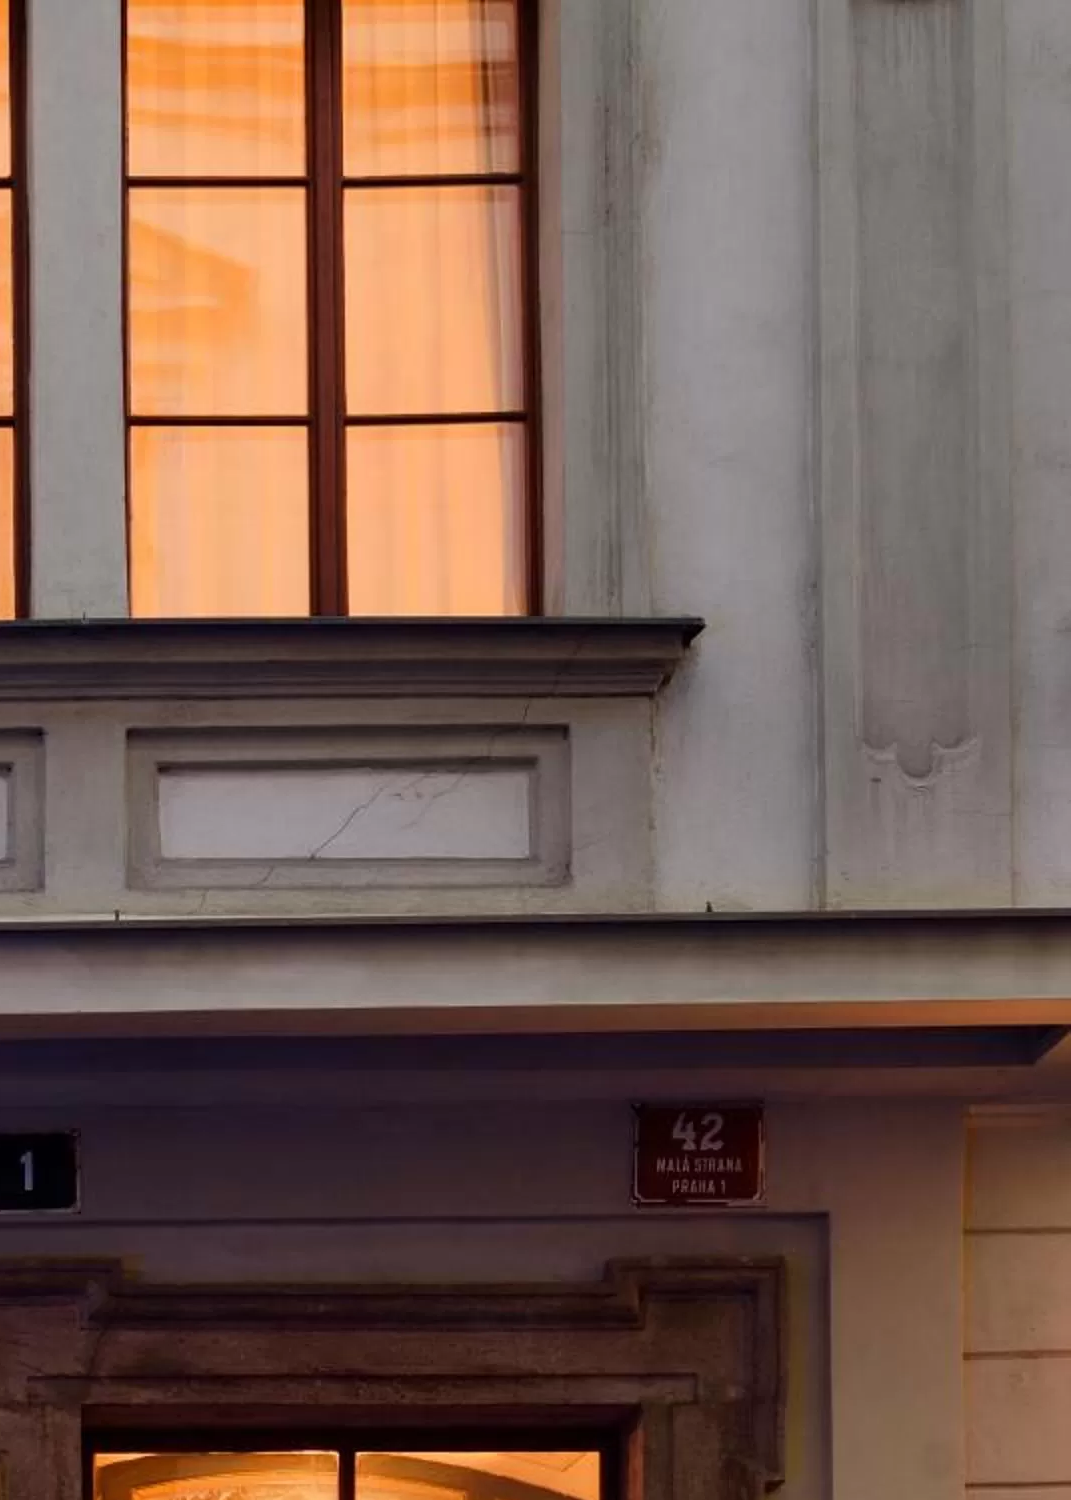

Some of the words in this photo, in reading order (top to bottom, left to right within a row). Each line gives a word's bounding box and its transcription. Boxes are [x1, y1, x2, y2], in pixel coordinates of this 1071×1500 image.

[672, 1112, 725, 1151] 42
[20, 1151, 34, 1191] 1
[694, 1157, 743, 1173] STRANA
[672, 1179, 716, 1195] PRAHA
[720, 1179, 727, 1194] 1
